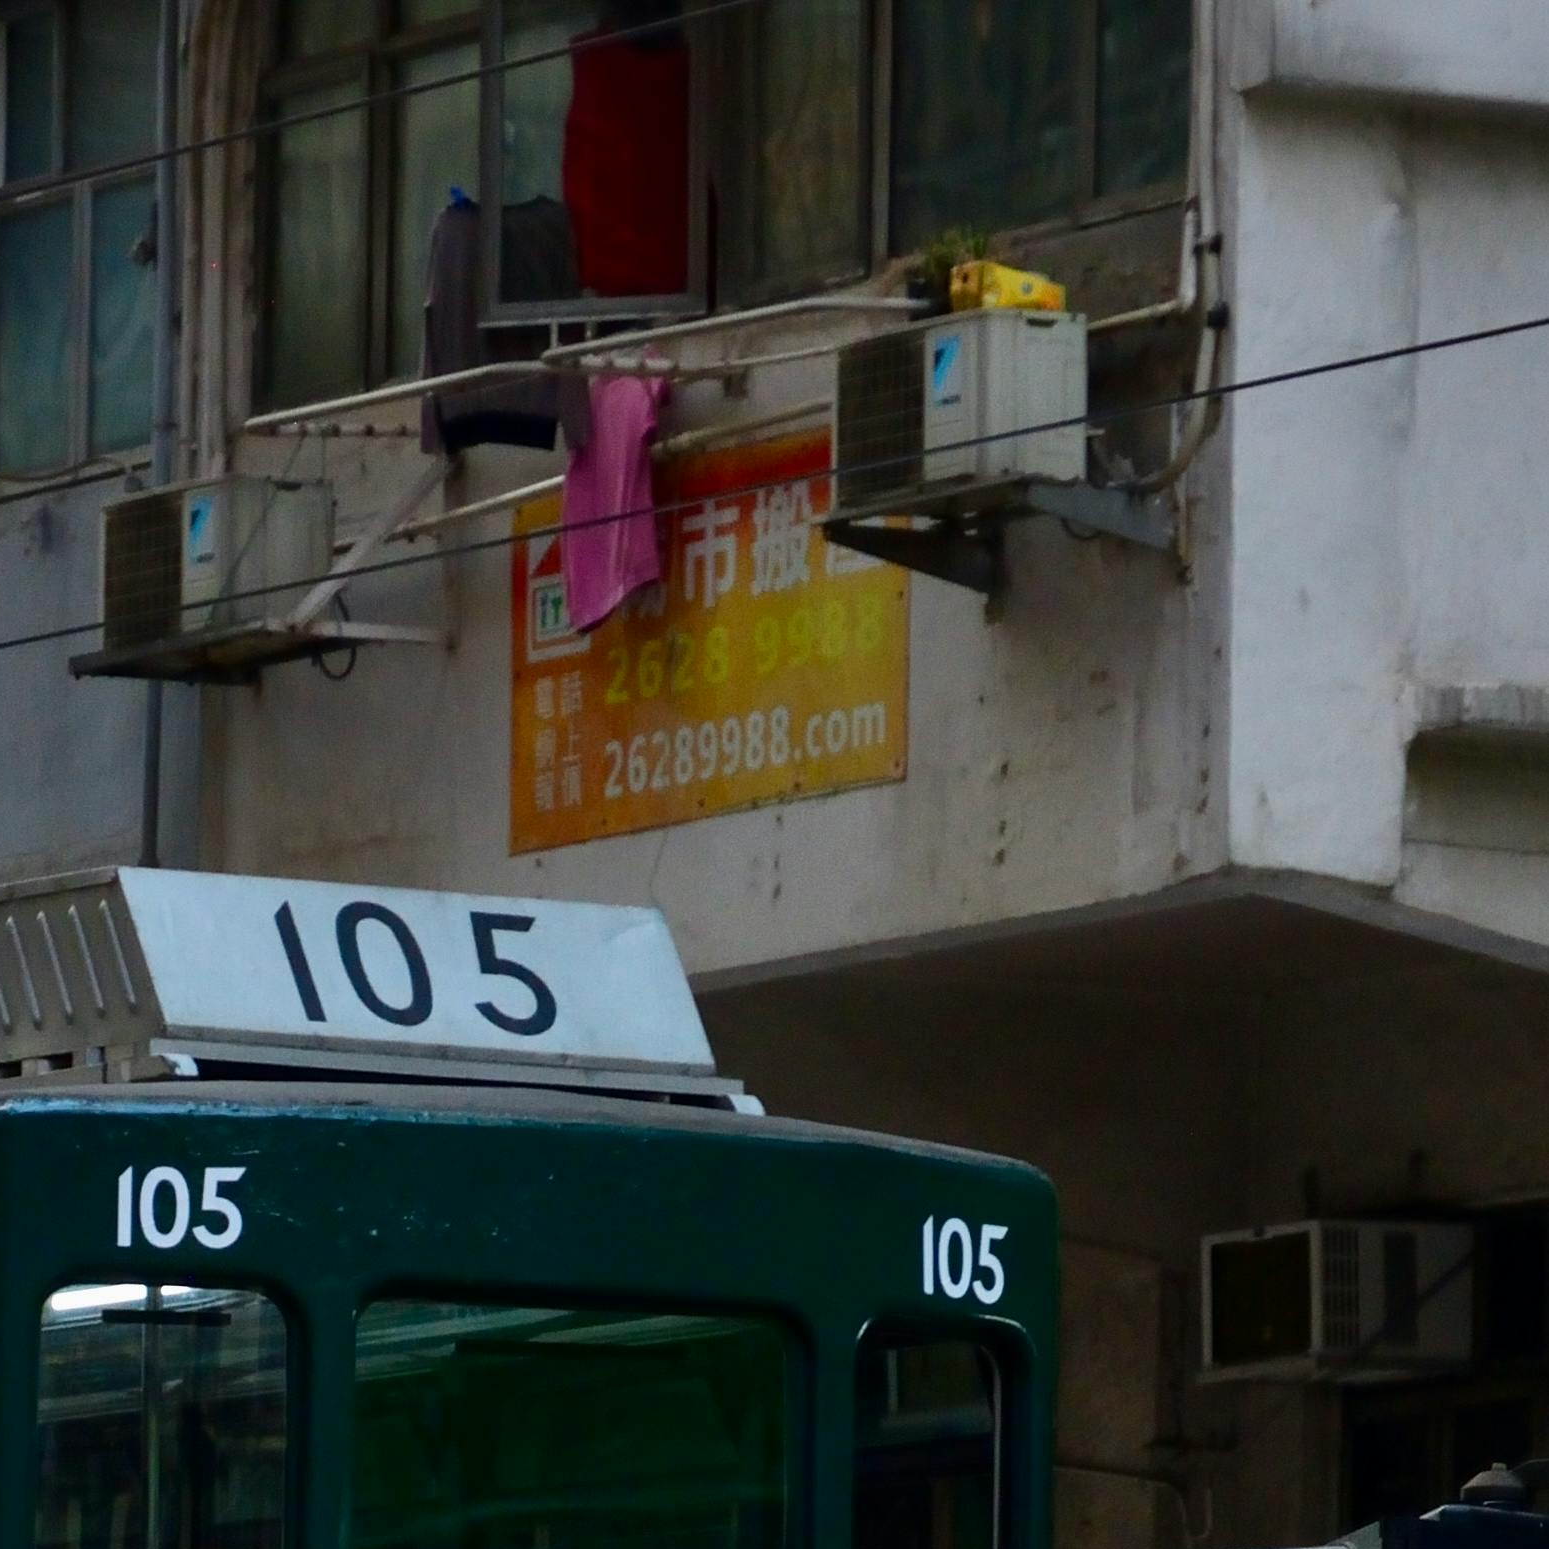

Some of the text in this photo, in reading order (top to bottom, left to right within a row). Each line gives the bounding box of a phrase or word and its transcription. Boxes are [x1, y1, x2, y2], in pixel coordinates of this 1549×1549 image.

[604, 625, 731, 704] 2628
[605, 702, 886, 799] 26289988.com
[272, 900, 557, 1036] 105
[116, 1166, 247, 1249] 105
[922, 1216, 1008, 1304] 105
